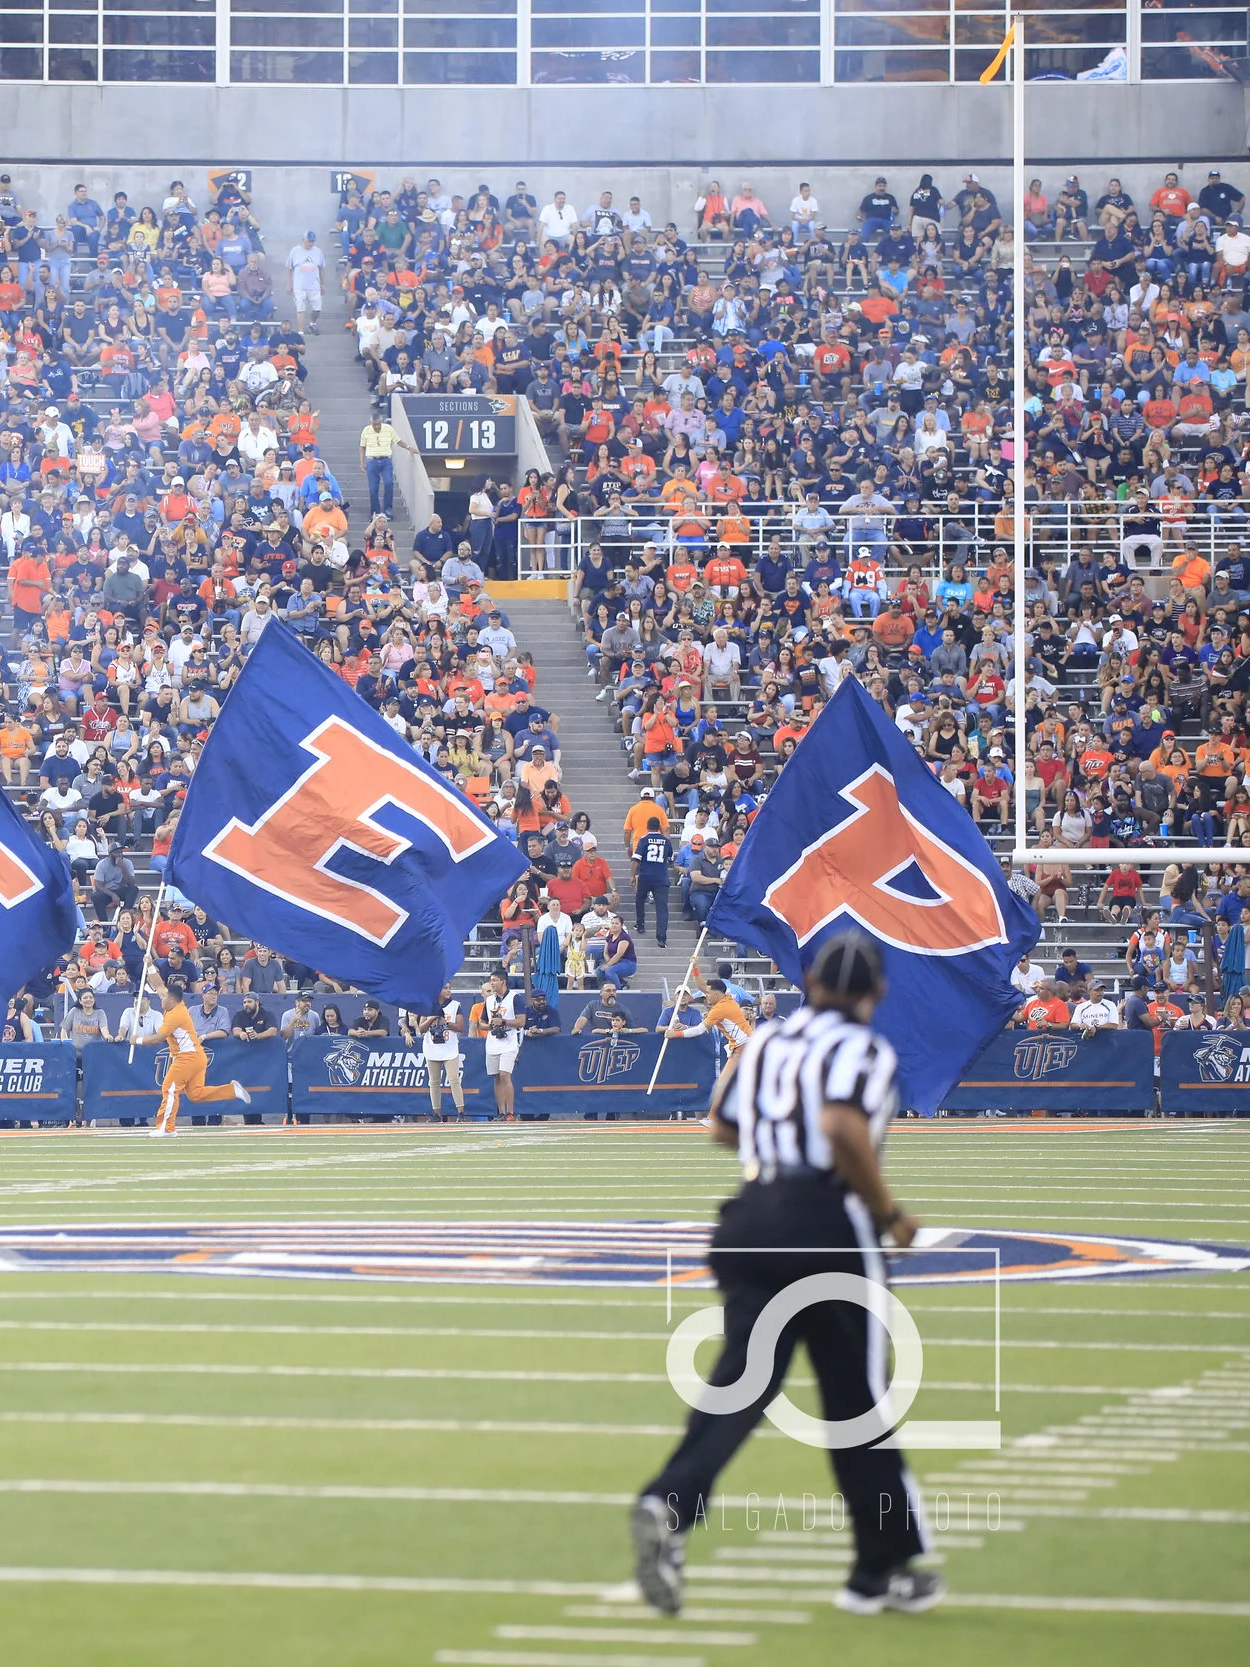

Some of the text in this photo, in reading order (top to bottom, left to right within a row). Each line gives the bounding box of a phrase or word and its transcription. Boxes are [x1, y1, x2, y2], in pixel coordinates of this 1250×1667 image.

[439, 401, 479, 411] SECTIONS
[423, 420, 448, 449] 12
[470, 420, 496, 449] 13
[80, 454, 106, 467] TOUCH
[201, 714, 498, 948] E
[646, 844, 663, 862] 21
[761, 763, 1010, 958] P
[367, 1052, 466, 1068] MIN
[578, 1039, 640, 1083] UTEP
[1014, 1035, 1078, 1080] UTEP
[7, 1075, 43, 1093] CLUB
[361, 1068, 425, 1087] ATHLETIC
